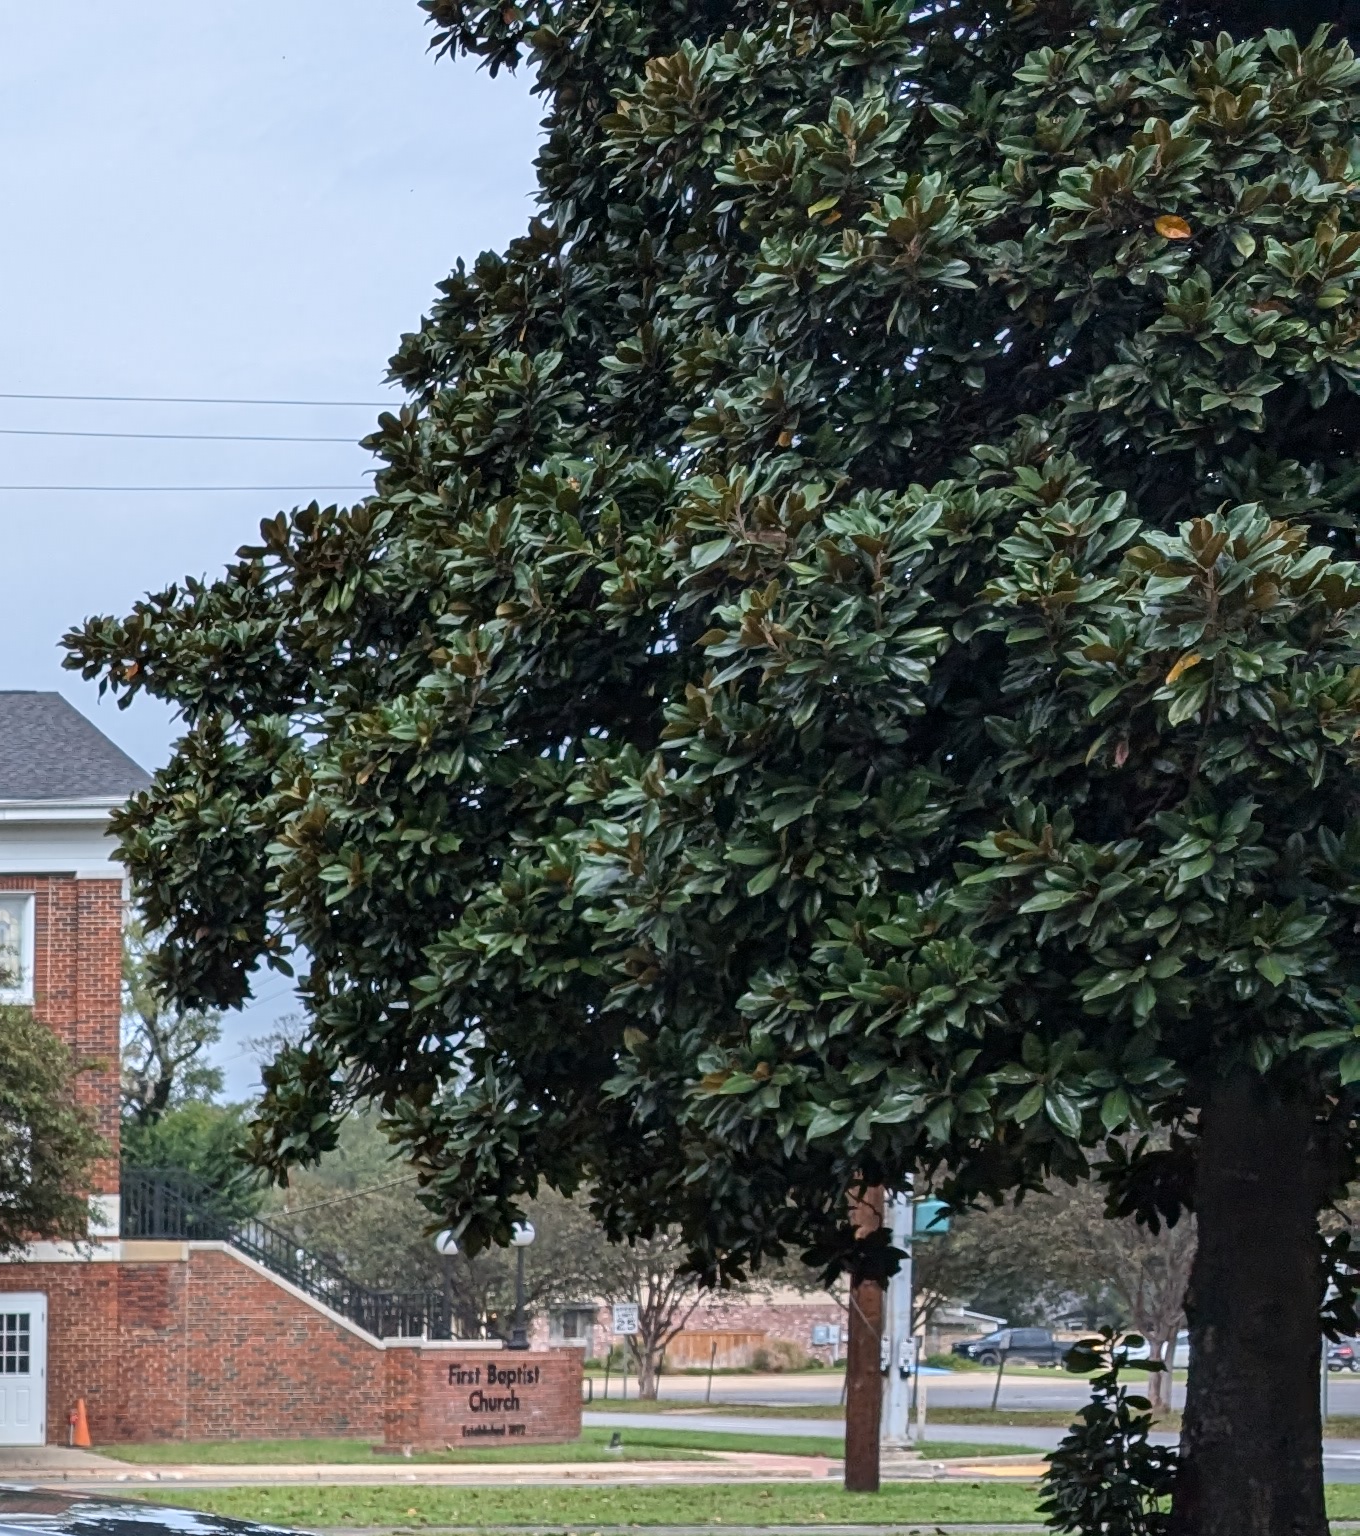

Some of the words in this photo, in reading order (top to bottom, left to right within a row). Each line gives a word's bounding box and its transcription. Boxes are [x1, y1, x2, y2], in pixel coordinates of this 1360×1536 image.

[617, 1318, 636, 1331] 25
[448, 1364, 480, 1385] First
[487, 1362, 540, 1389] Baptist
[468, 1389, 520, 1412] Church
